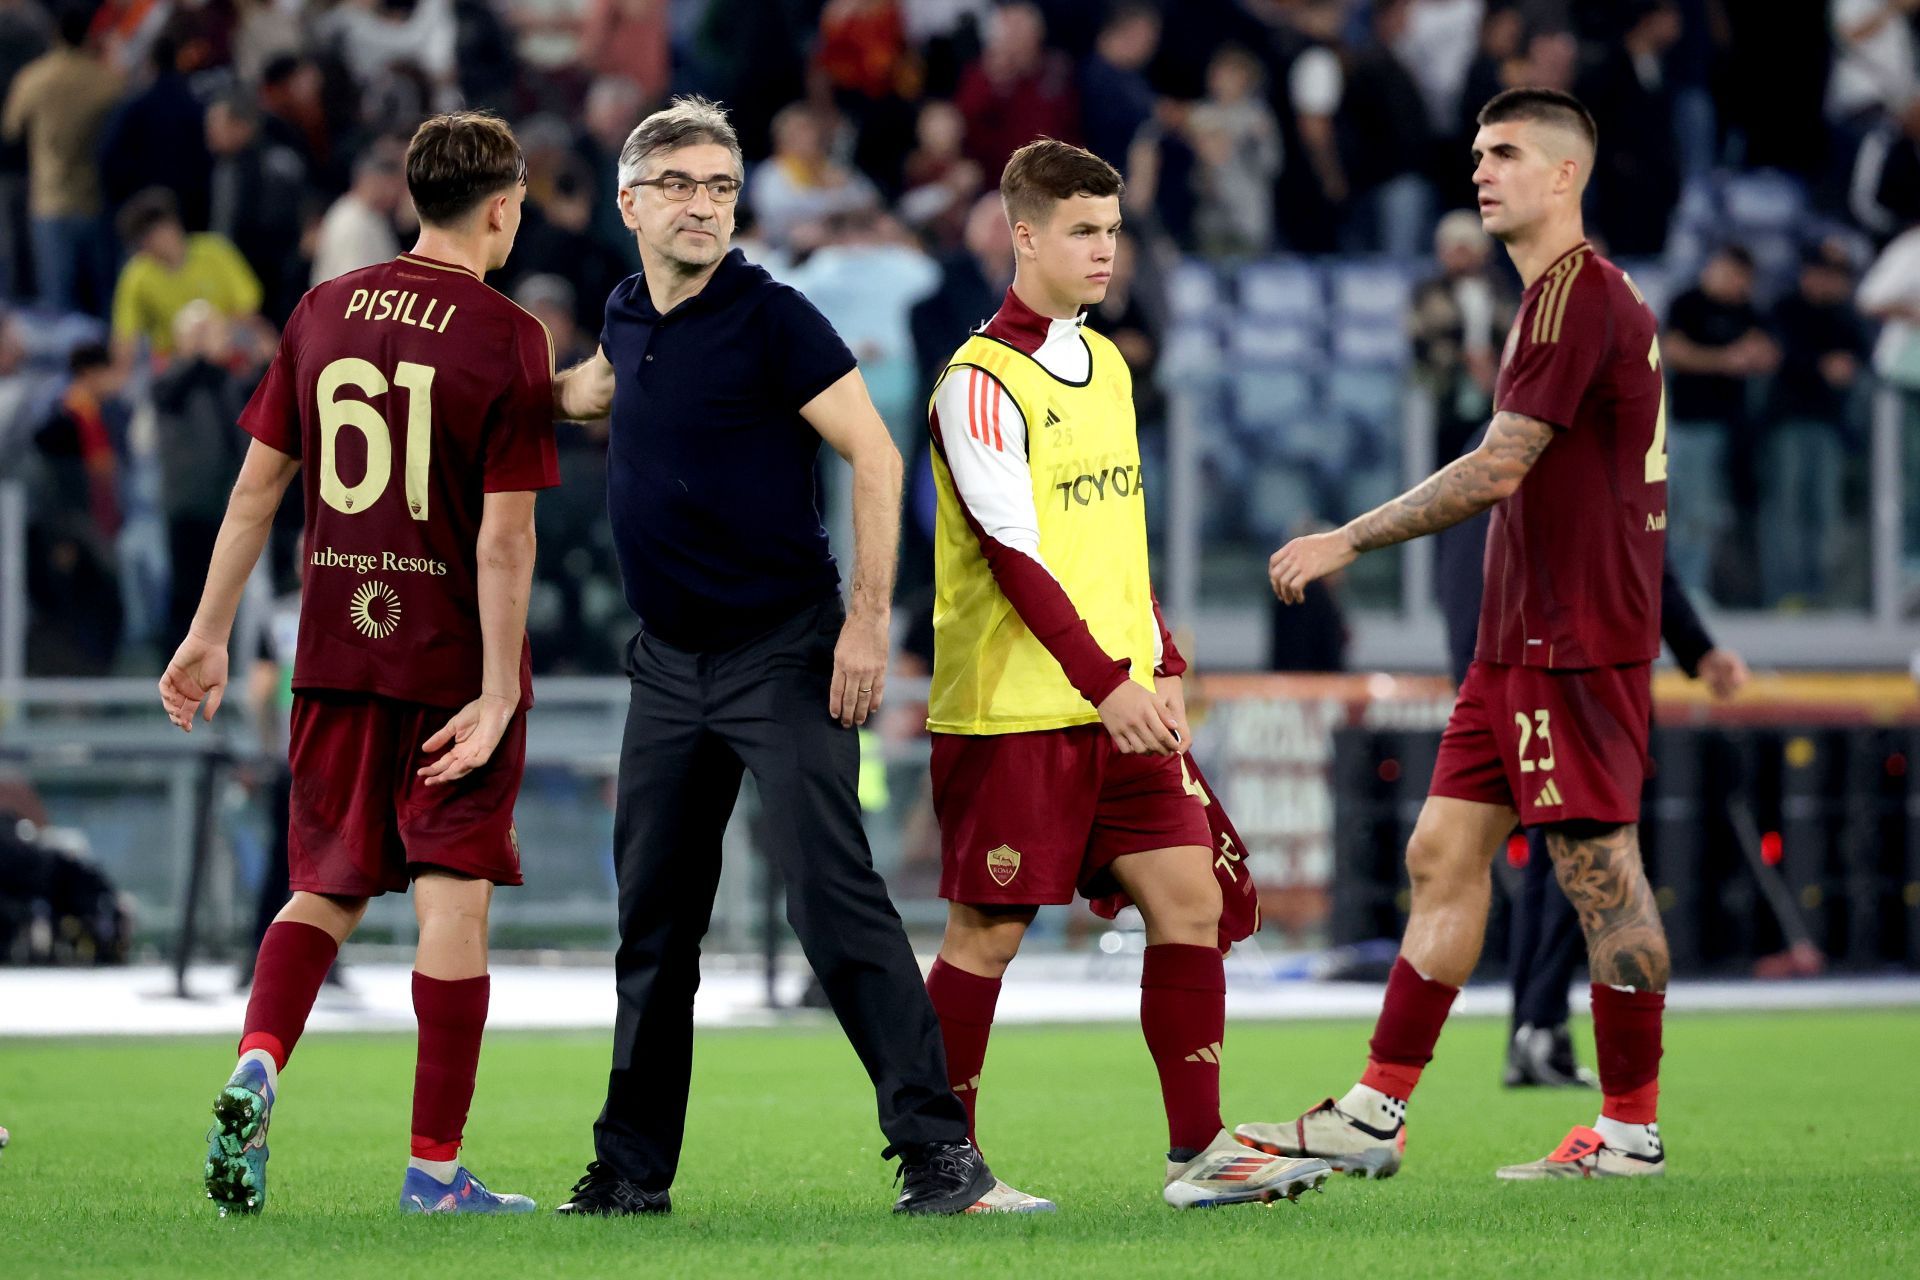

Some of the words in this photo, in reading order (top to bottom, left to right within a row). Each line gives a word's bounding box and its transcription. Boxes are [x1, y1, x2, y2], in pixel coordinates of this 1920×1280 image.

[344, 289, 457, 333] PISILLI
[317, 357, 436, 521] 61
[1515, 709, 1555, 772] 23
